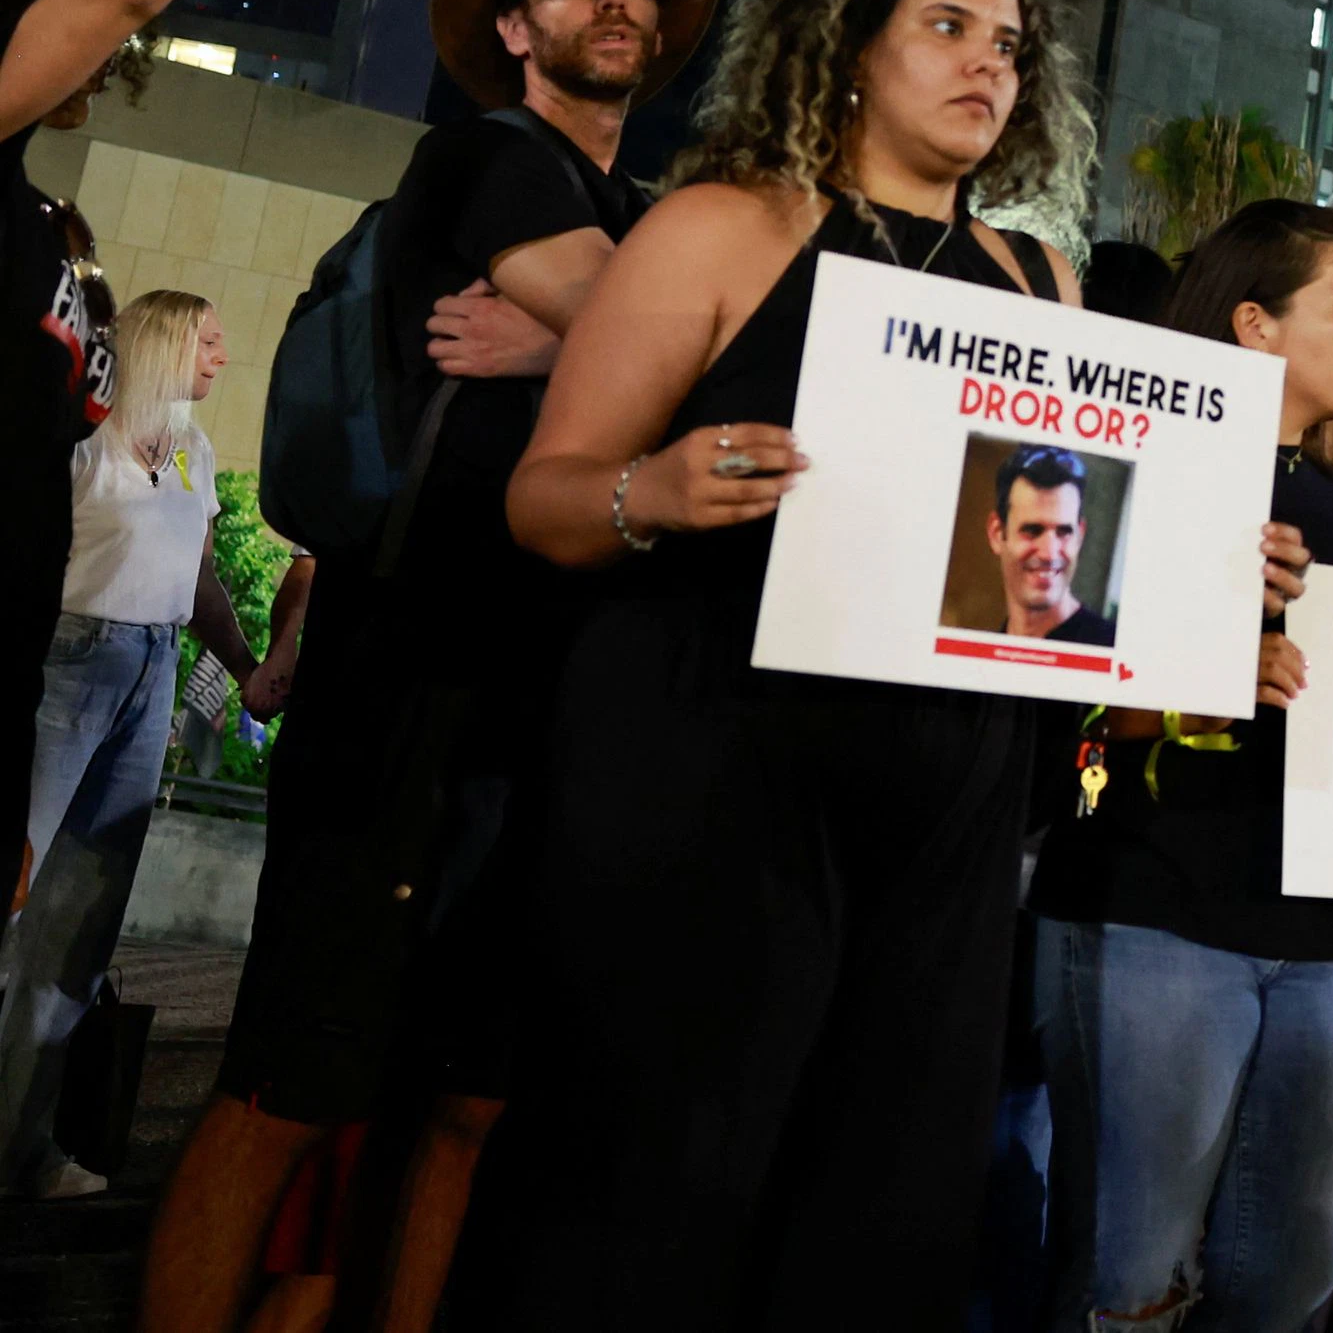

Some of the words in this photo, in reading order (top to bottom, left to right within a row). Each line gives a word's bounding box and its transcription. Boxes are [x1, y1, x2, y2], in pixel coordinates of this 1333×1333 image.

[884, 317, 940, 366] I'M
[949, 331, 1054, 386] HERE.
[1066, 356, 1188, 415] WHERE
[1196, 385, 1225, 423] IS
[959, 377, 1064, 433] DROR
[1074, 403, 1151, 449] OR?
